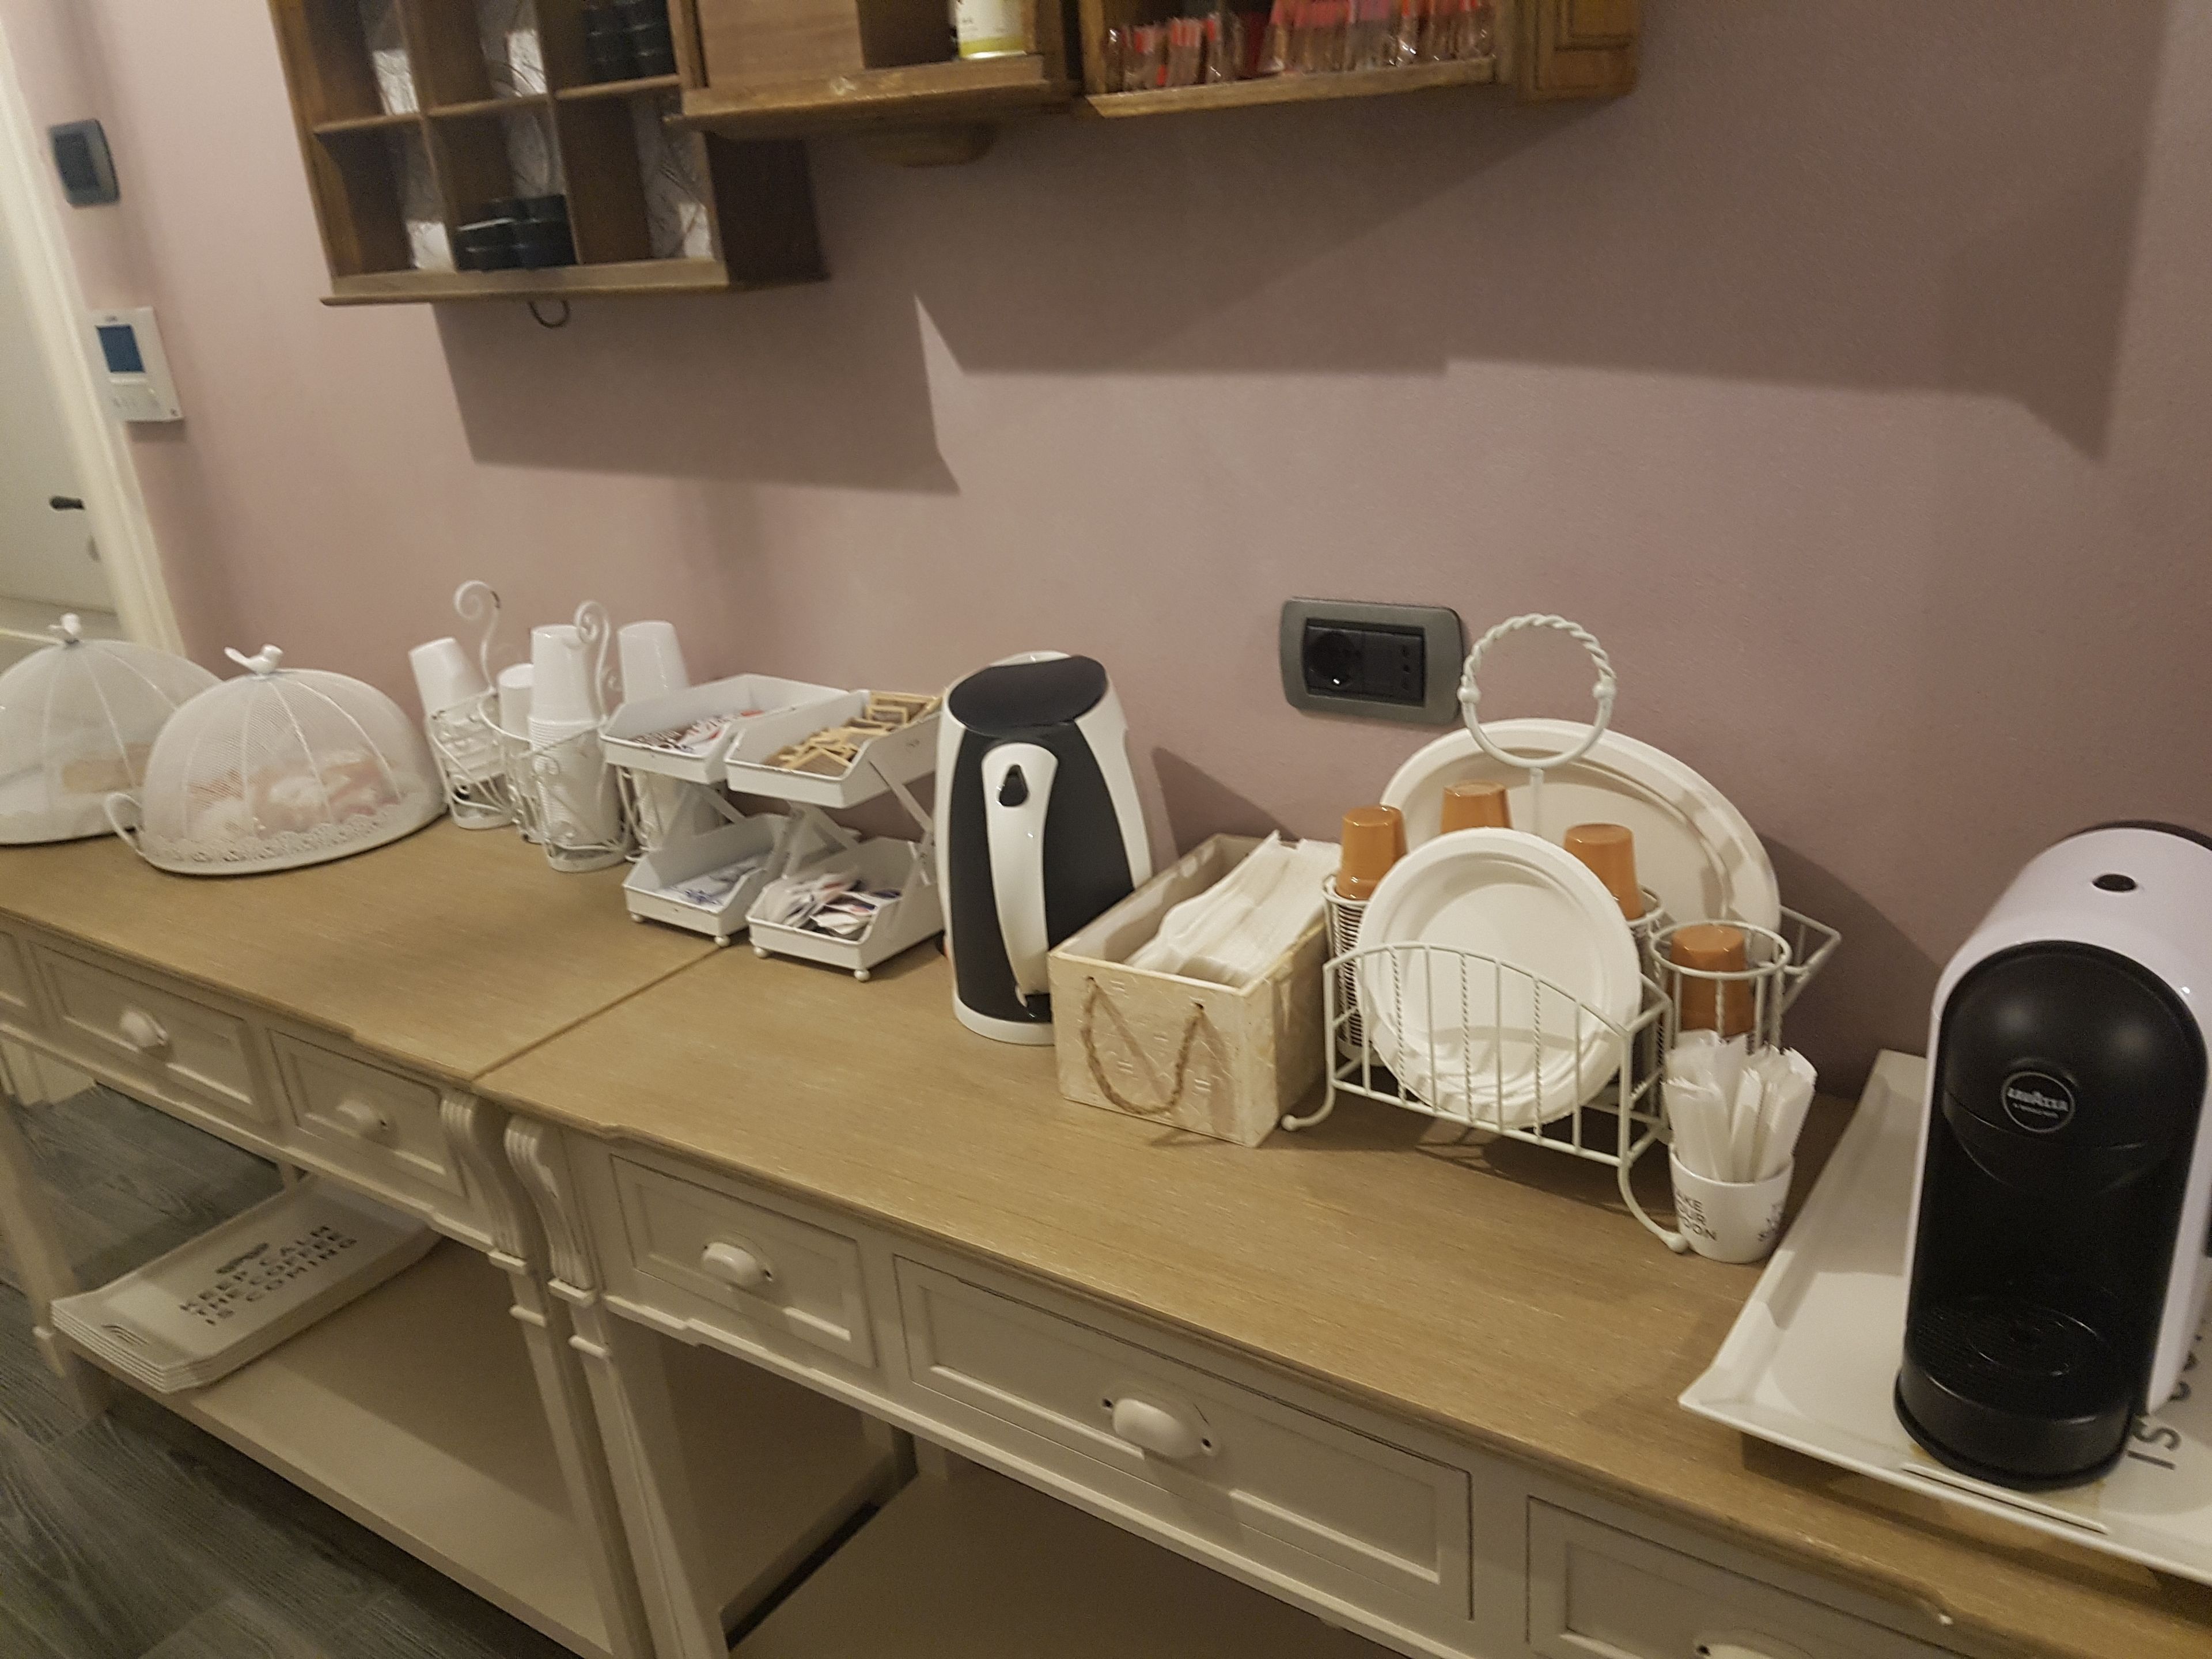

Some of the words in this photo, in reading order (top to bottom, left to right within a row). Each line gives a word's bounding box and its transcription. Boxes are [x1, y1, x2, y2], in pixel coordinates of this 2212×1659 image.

[205, 1308, 235, 1325] IS
[245, 1236, 358, 1302] COMING
[2127, 1415, 2181, 1471] IS
